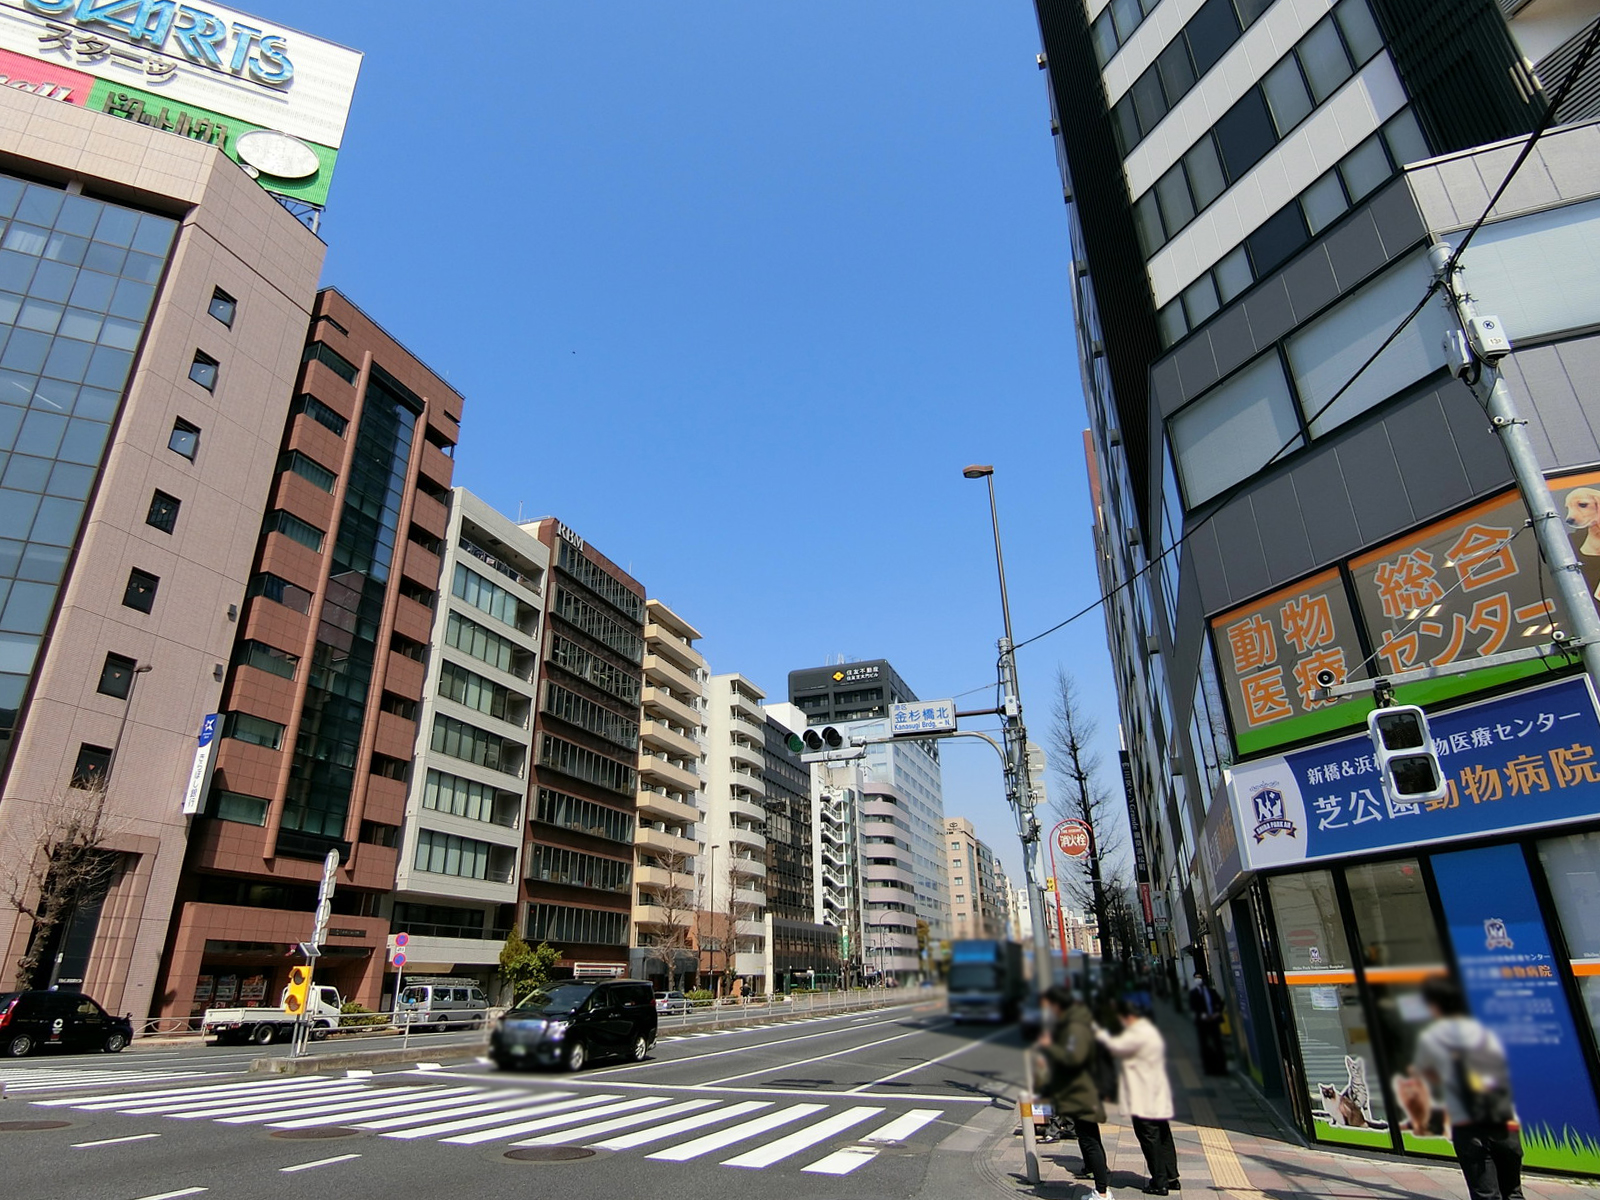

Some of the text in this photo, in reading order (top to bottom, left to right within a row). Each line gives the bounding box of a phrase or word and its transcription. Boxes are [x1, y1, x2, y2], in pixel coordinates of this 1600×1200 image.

[24, 0, 294, 83] ARTS
[38, 23, 178, 76] スターツ
[556, 520, 584, 552] RBM
[1374, 523, 1519, 619] 総合
[1227, 594, 1335, 674] 動物
[1377, 592, 1556, 674] センター
[846, 666, 879, 676] 住友不動産
[894, 707, 949, 724] 金杉橋北
[894, 723, 920, 731] Kanasugi
[922, 721, 937, 729] Brdg.
[1060, 833, 1087, 847] 消火栓
